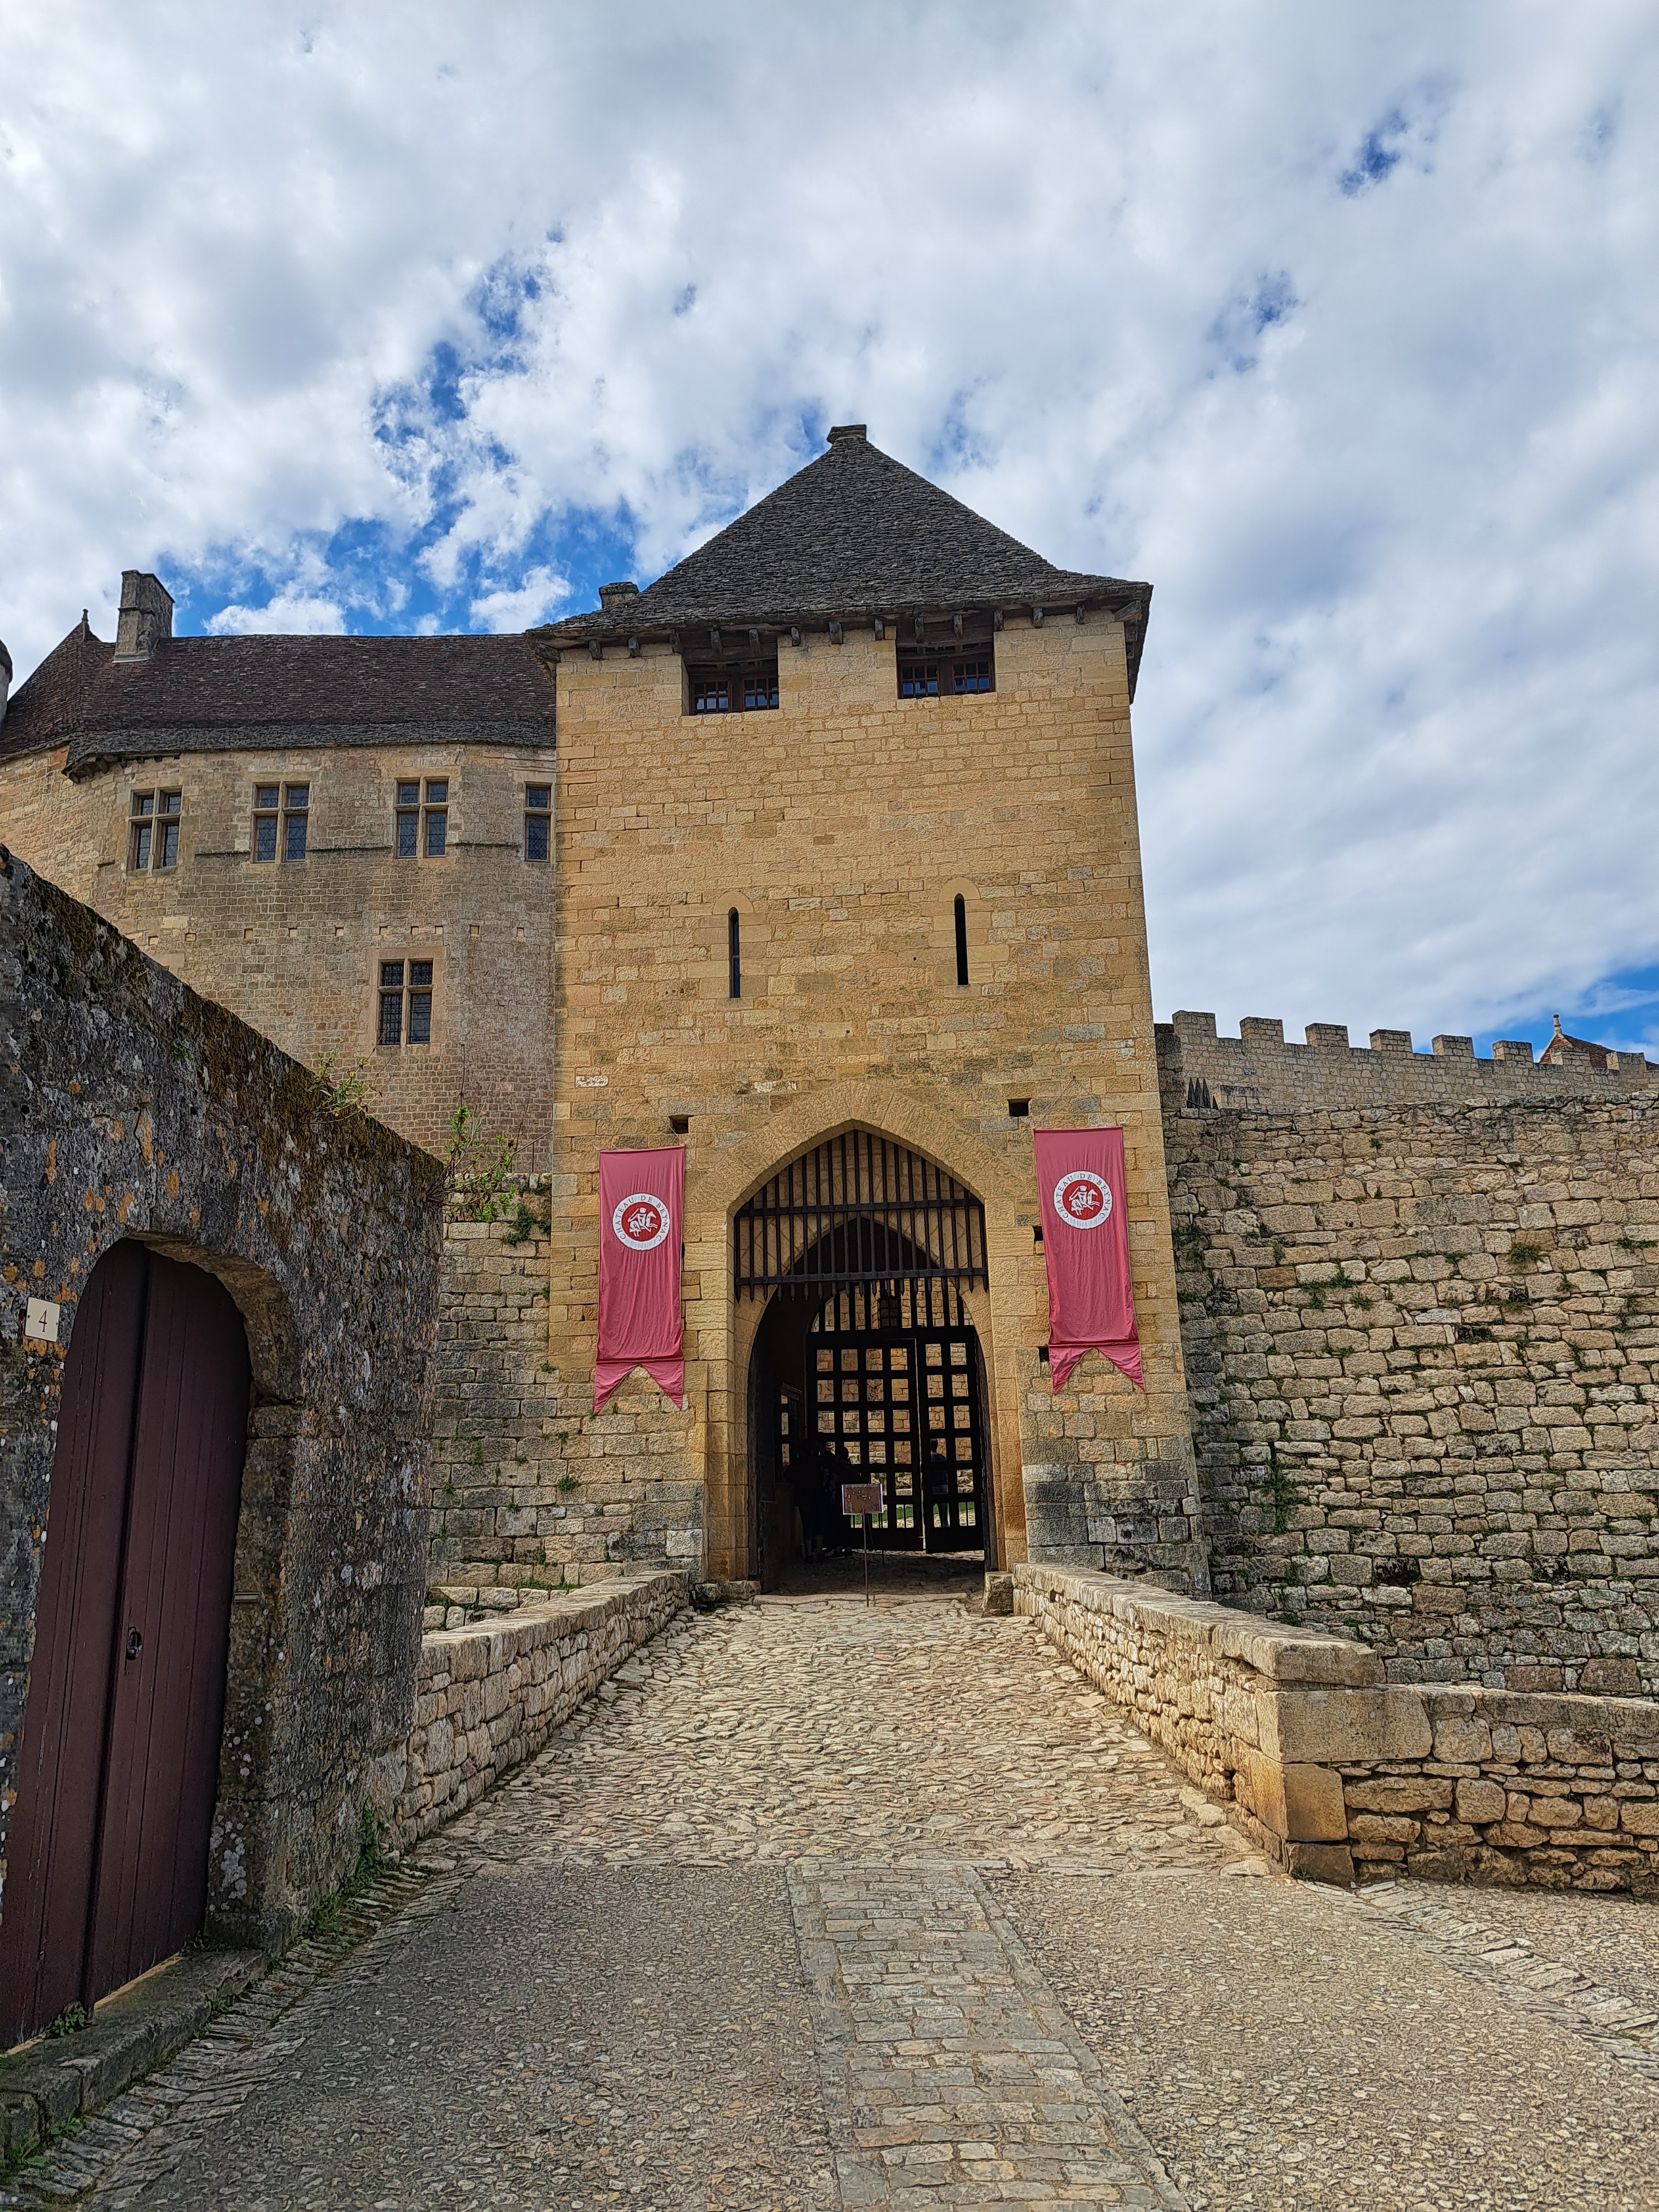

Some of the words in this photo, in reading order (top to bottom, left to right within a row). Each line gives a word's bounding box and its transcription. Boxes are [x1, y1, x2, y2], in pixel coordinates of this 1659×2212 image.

[615, 1197, 634, 1239] CHATEAU
[655, 1202, 668, 1241] BEYNAC
[1056, 1175, 1073, 1218] CHATEAU
[1096, 1179, 1111, 1219] BEYNAC
[38, 1309, 47, 1332] 4
